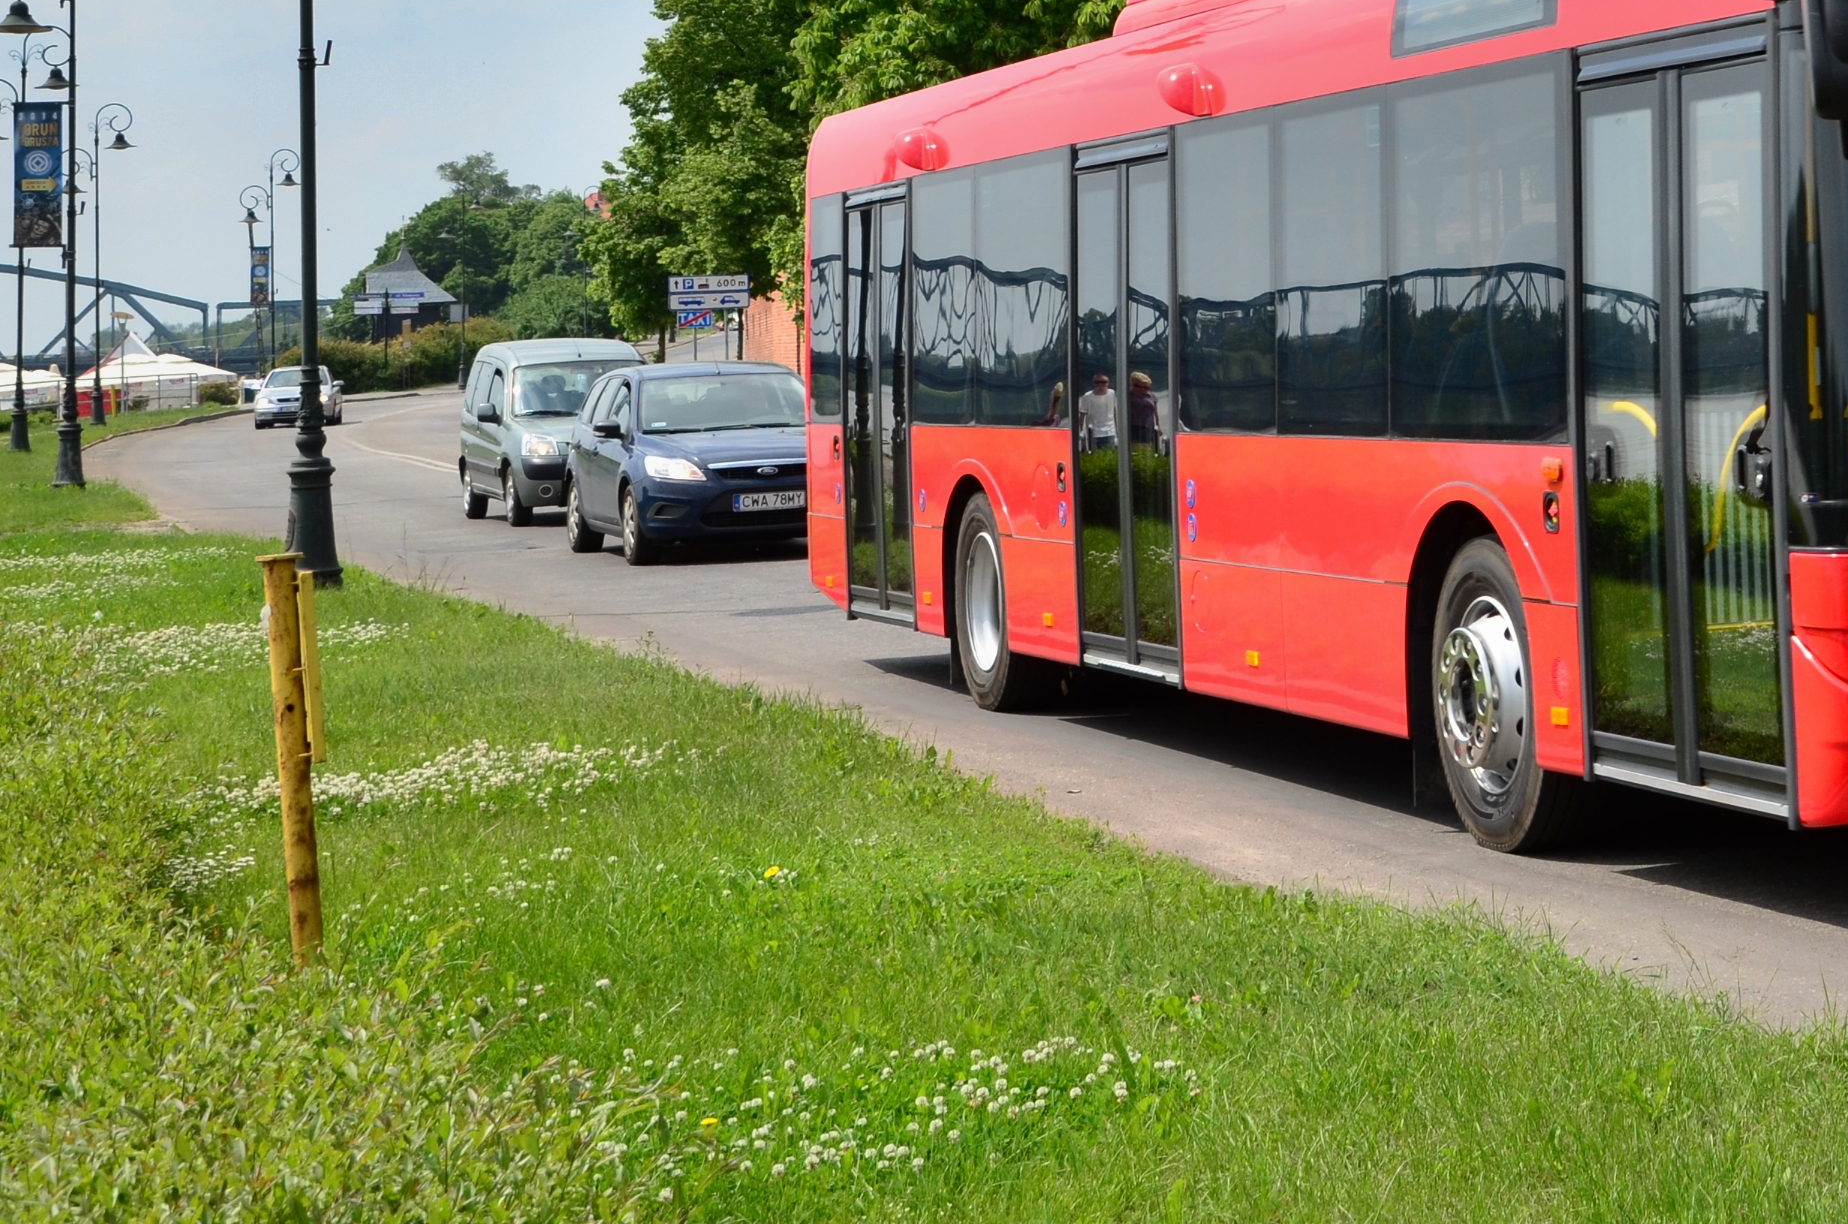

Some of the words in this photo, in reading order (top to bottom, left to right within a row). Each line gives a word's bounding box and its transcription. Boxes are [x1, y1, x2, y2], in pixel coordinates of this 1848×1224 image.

[685, 279, 692, 289] P
[717, 279, 736, 287] 600
[679, 313, 710, 325] TAXI
[742, 495, 768, 508] CWA
[773, 493, 802, 506] 78MY
